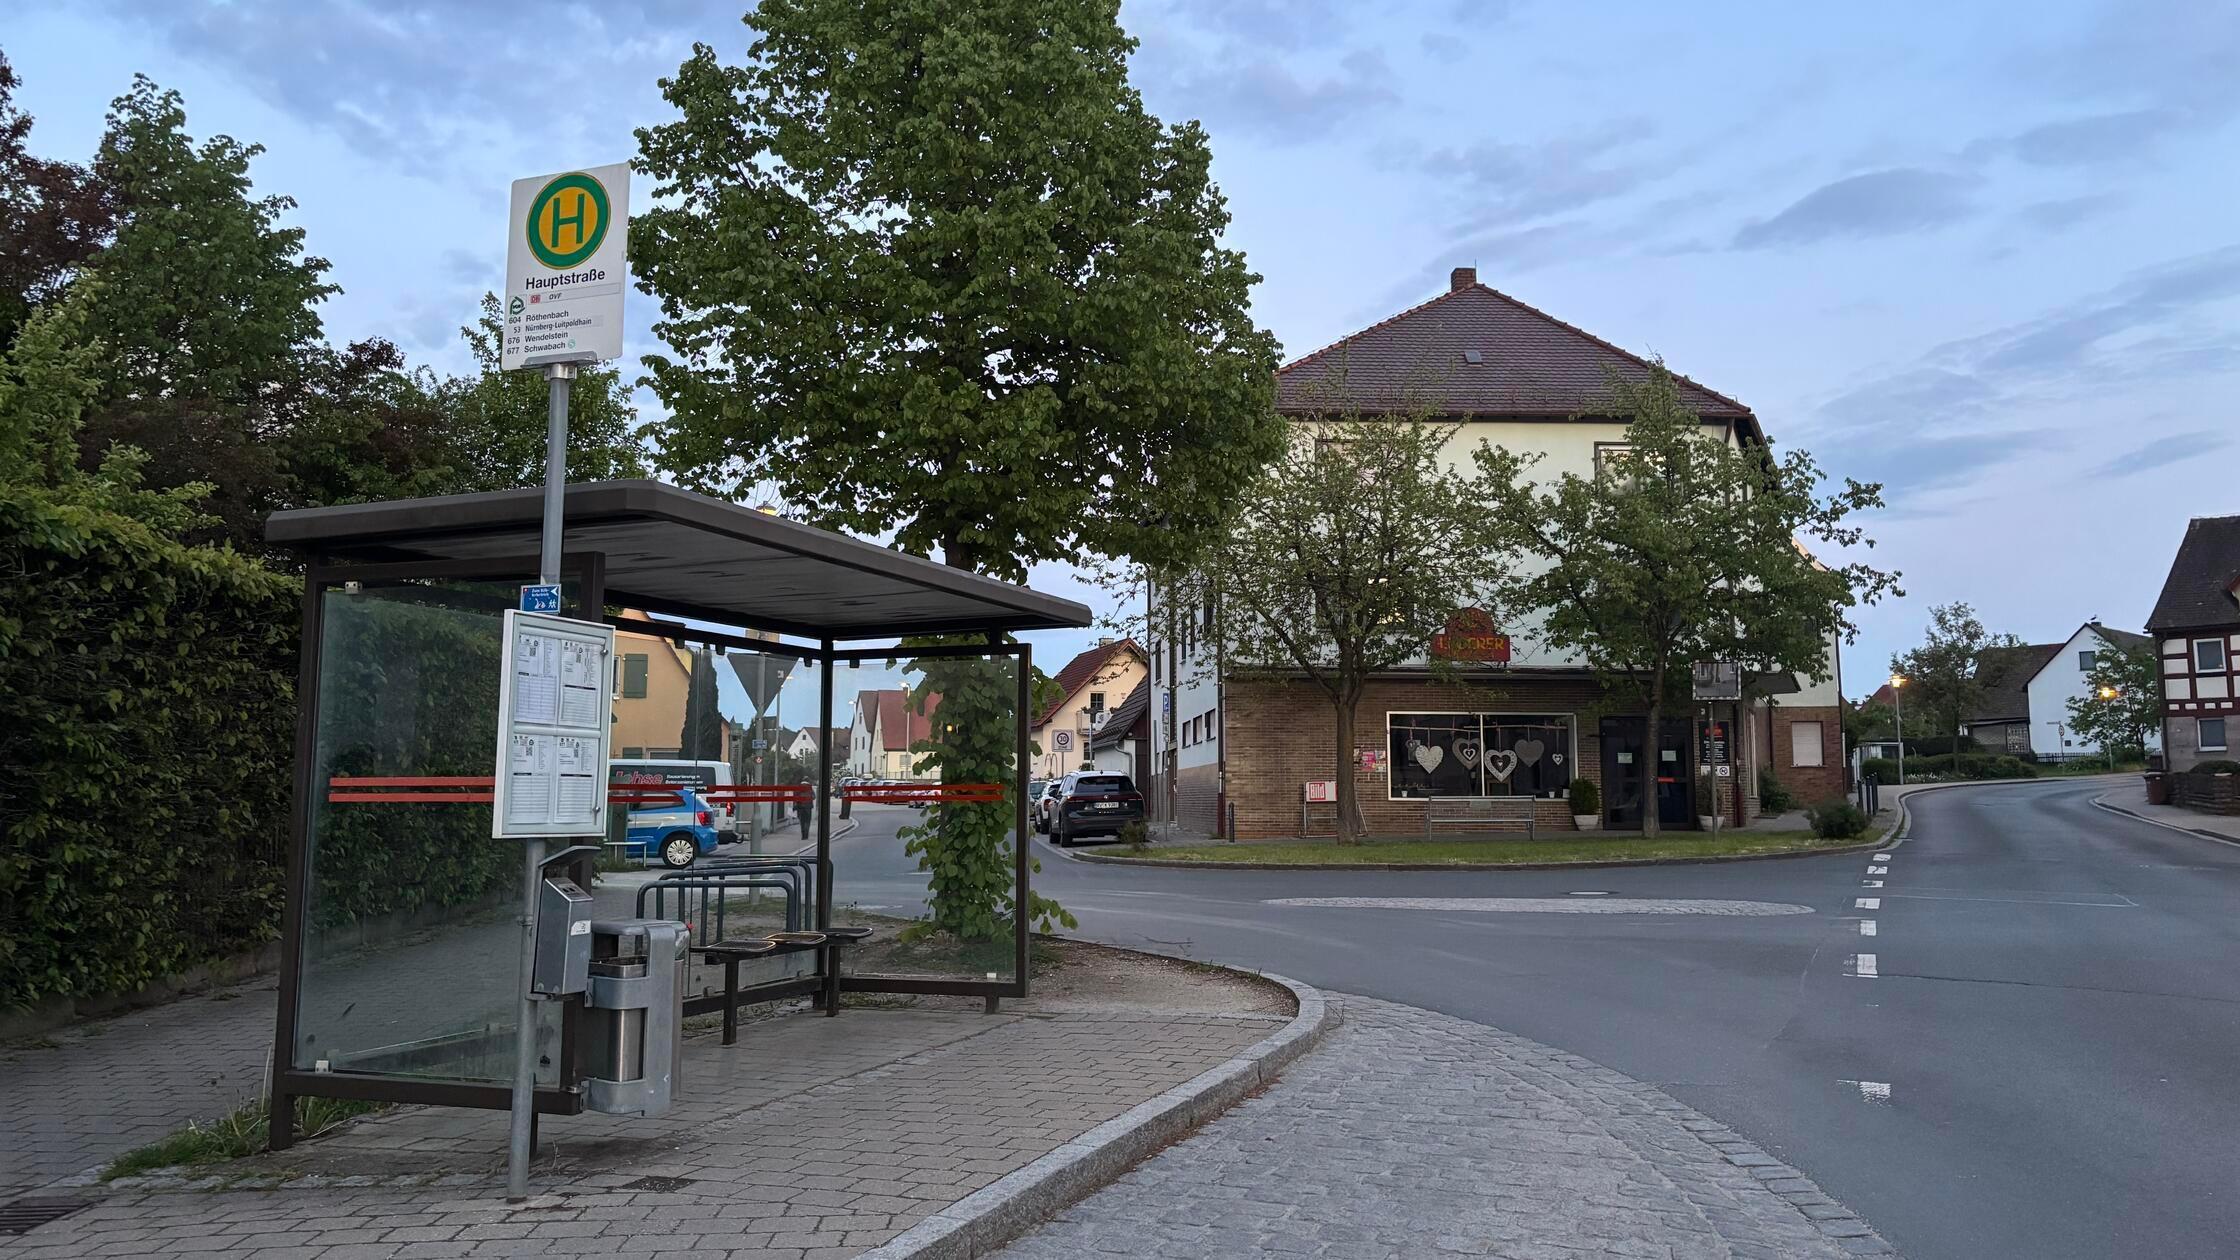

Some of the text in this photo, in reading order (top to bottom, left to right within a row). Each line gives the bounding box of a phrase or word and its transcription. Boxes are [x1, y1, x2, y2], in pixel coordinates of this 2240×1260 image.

[551, 193, 585, 248] H
[526, 268, 605, 290] Hauptstraße
[508, 310, 569, 325] 604 Röthenbach
[513, 318, 592, 334] 53 Nürnberg-Luitpoldhain
[507, 331, 569, 345] 676 Wendelstein
[506, 346, 520, 355] 677
[524, 341, 566, 353] Schwabach
[1311, 784, 1325, 798] Bild
